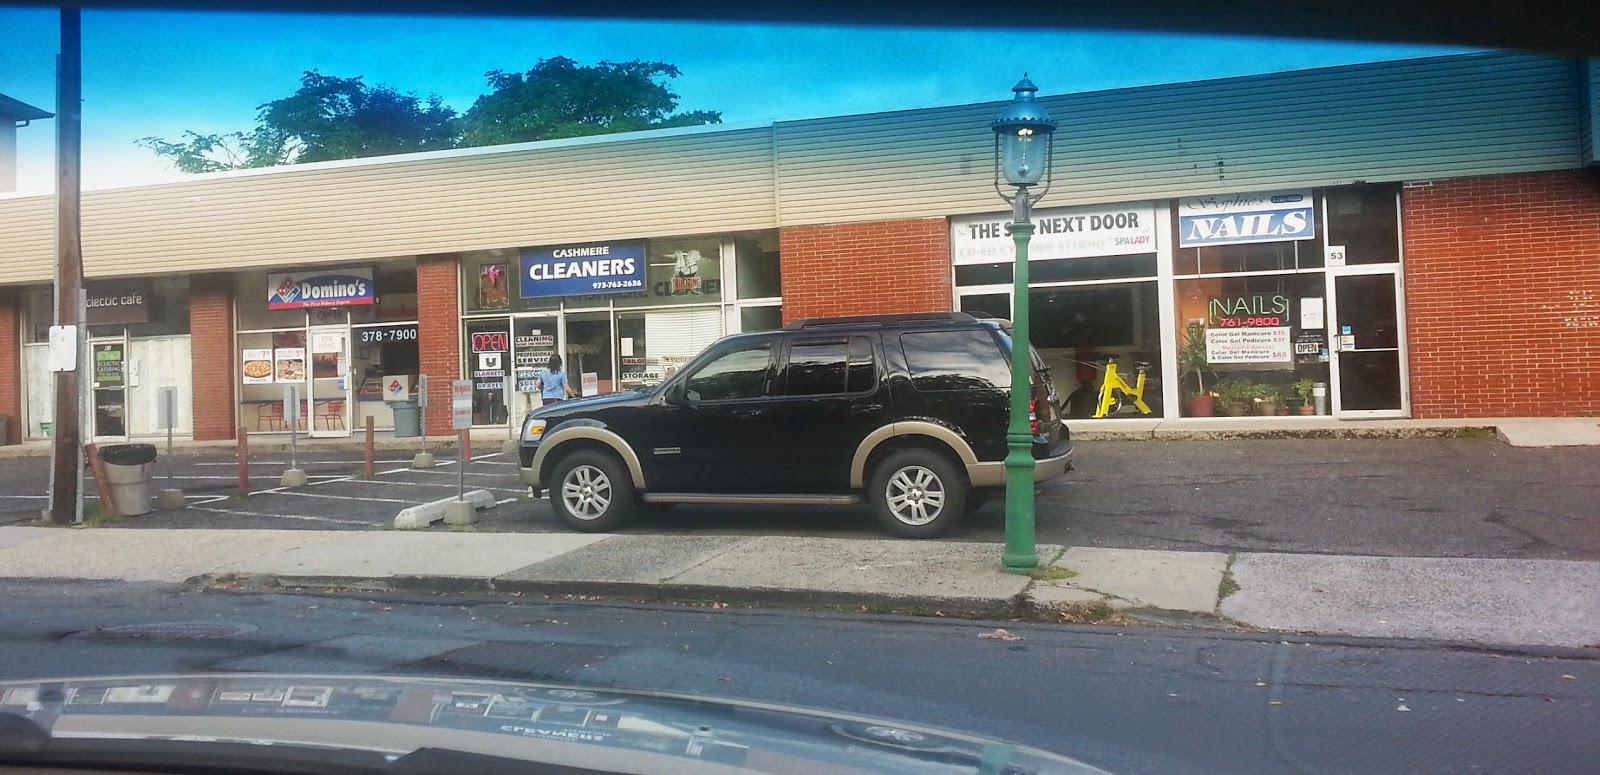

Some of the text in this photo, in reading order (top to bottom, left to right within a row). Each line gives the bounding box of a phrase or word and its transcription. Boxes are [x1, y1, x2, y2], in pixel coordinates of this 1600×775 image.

[1187, 194, 1266, 212] Sophie's
[968, 222, 1000, 240] THE
[1040, 216, 1086, 235] NEXT
[1090, 212, 1139, 231] DOOR
[1186, 210, 1307, 241] NAILS
[553, 246, 610, 259] CASHMERE
[1331, 252, 1343, 260] 53
[529, 258, 636, 281] CLEANERS
[301, 279, 367, 300] Domino's
[592, 279, 642, 290] 973-763-2636
[121, 292, 142, 305] cafe
[1213, 295, 1285, 317] NAILS
[1220, 317, 1280, 327] 761-9800
[362, 329, 417, 342] 378-7900
[473, 334, 507, 351] OPEN
[1297, 343, 1317, 352] OPEN
[474, 370, 505, 378] BLANKETS
